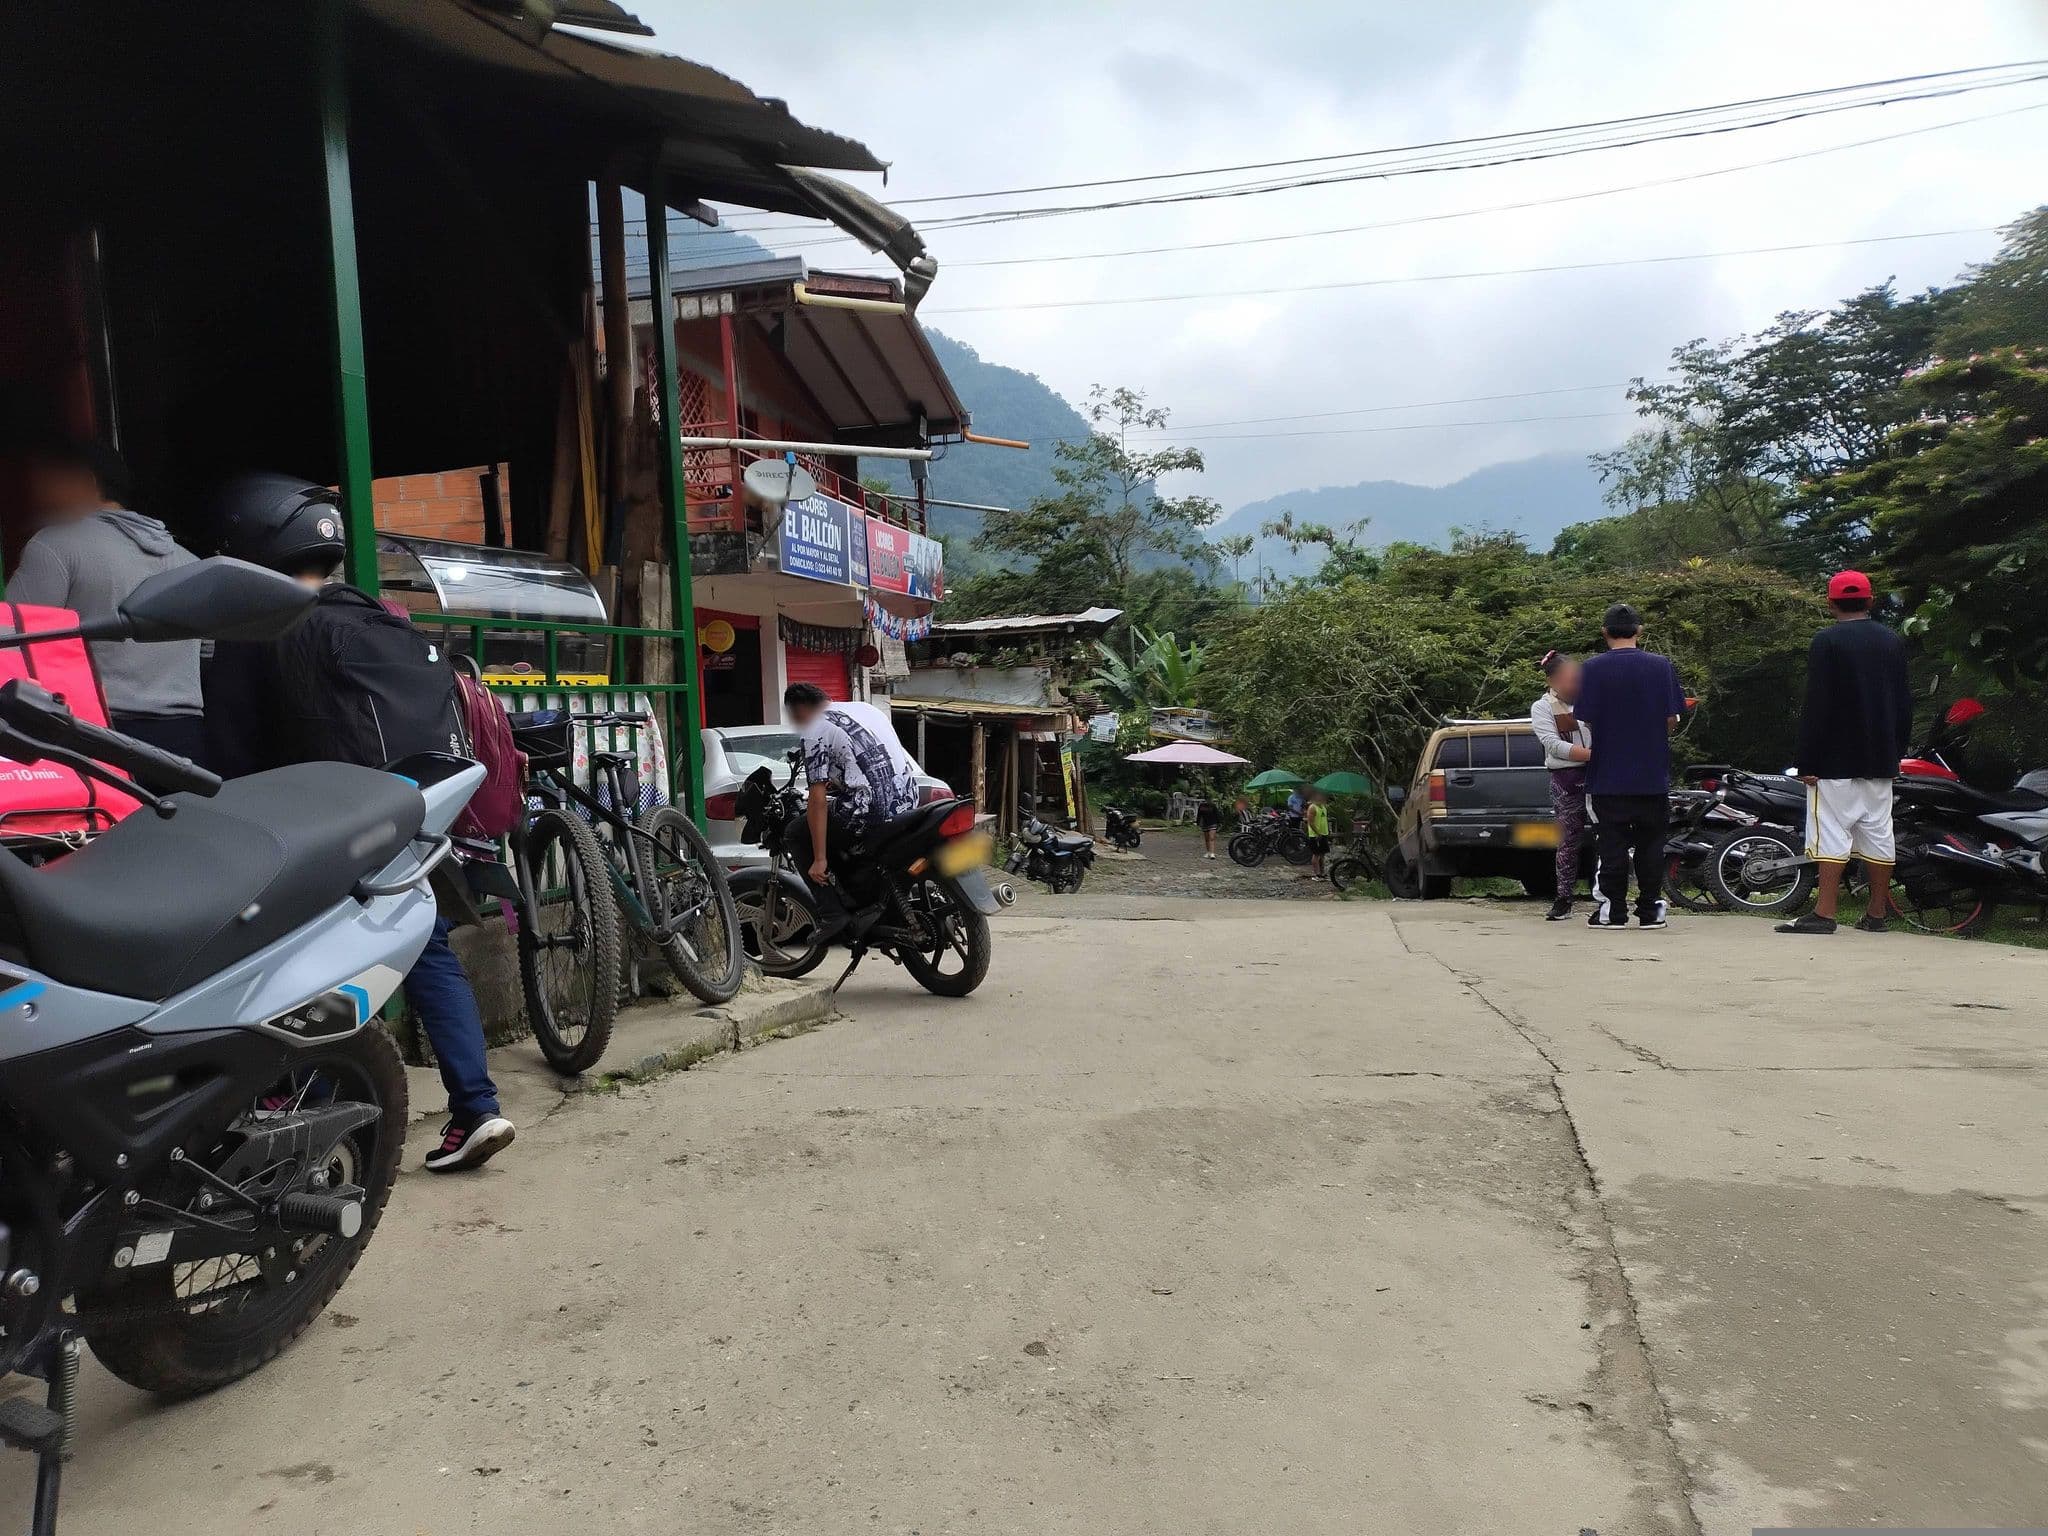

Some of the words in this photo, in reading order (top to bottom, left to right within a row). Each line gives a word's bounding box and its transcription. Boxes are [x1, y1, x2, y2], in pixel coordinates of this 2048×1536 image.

[785, 508, 799, 539] EL
[801, 514, 842, 551] BALCÓN
[13, 769, 33, 781] 10
[32, 768, 64, 780] min.
